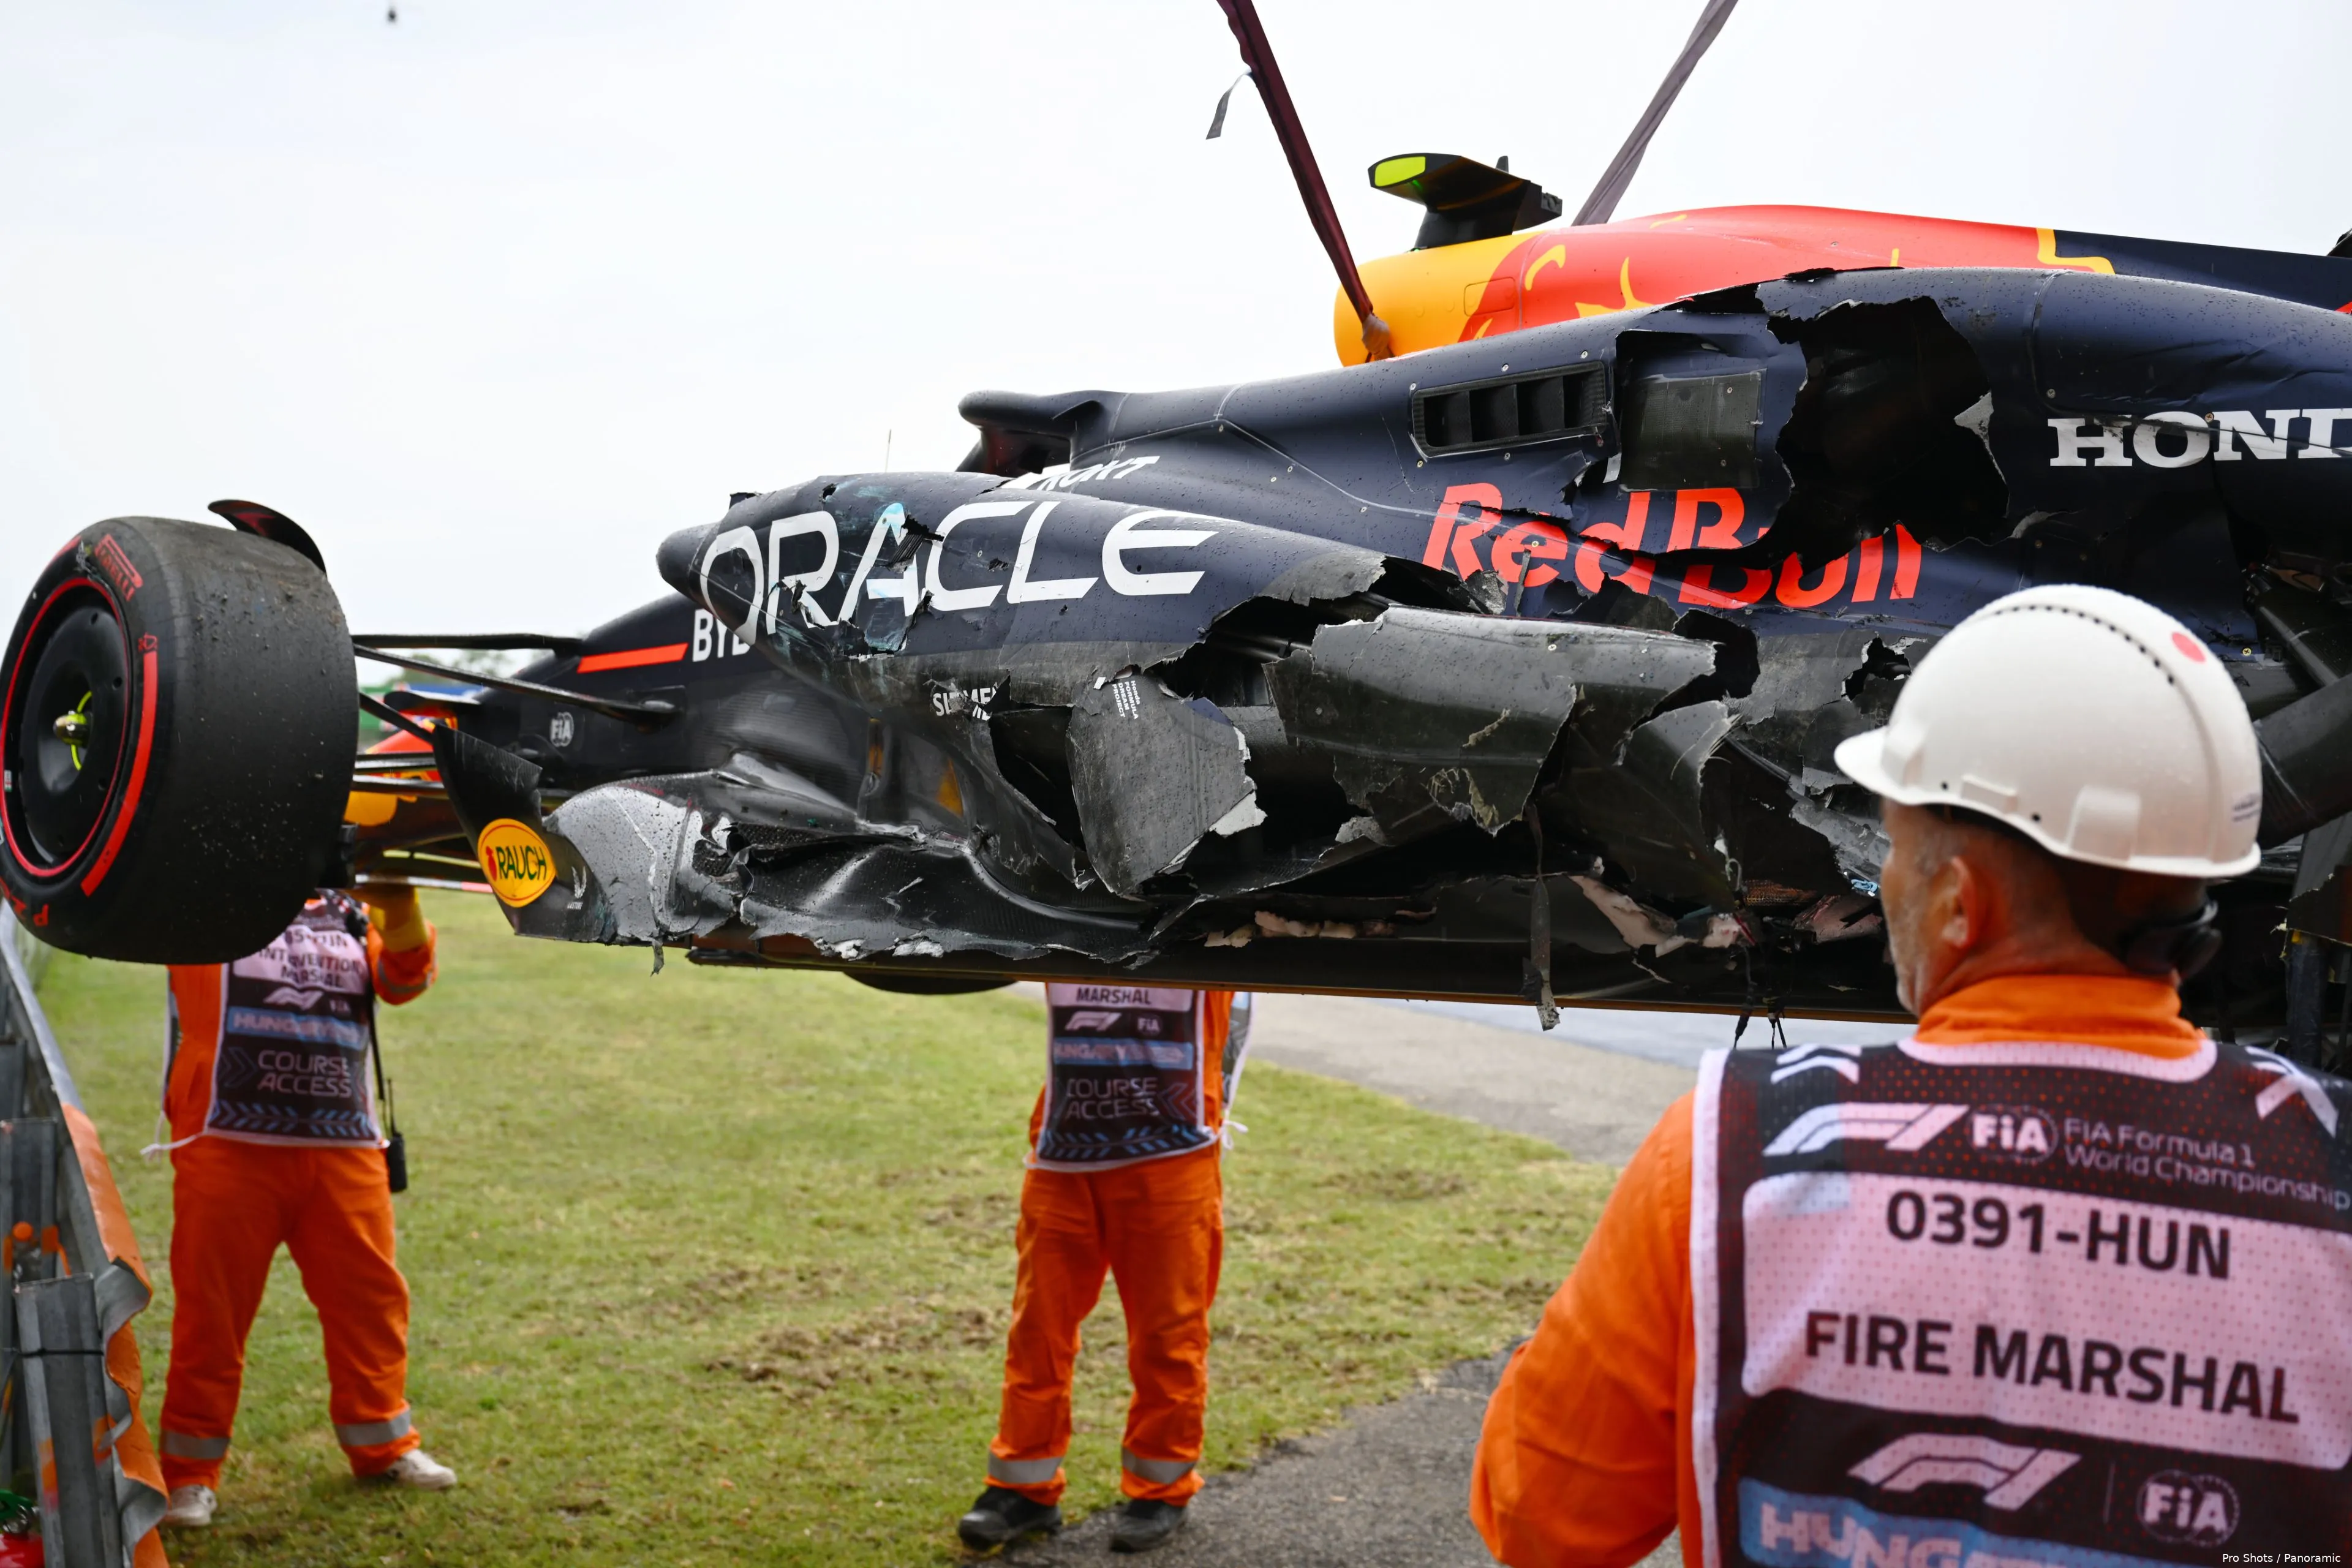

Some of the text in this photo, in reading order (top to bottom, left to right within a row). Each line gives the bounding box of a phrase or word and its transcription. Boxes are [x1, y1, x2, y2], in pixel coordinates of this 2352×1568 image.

[1422, 482, 1921, 609] Red Bull
[700, 500, 1218, 645] ORACLE
[1112, 684, 1126, 718] PROJECT
[1118, 682, 1130, 710] DREAM
[1125, 681, 1139, 720] FORMULA
[1131, 680, 1140, 705] Honda
[496, 845, 548, 881] RAUCH
[1076, 987, 1152, 1005] MARSHAL
[258, 1050, 350, 1077] COURSE
[258, 1073, 352, 1098] ACCESS
[1067, 1077, 1158, 1098] COURSE
[1065, 1098, 1160, 1119] ACCESS
[2064, 1117, 2255, 1167] FIA Formula 1
[2064, 1144, 2351, 1210] World Championship
[1887, 1190, 2230, 1280] 0391-HUN
[1805, 1310, 2300, 1425] FIRE MARSHAL
